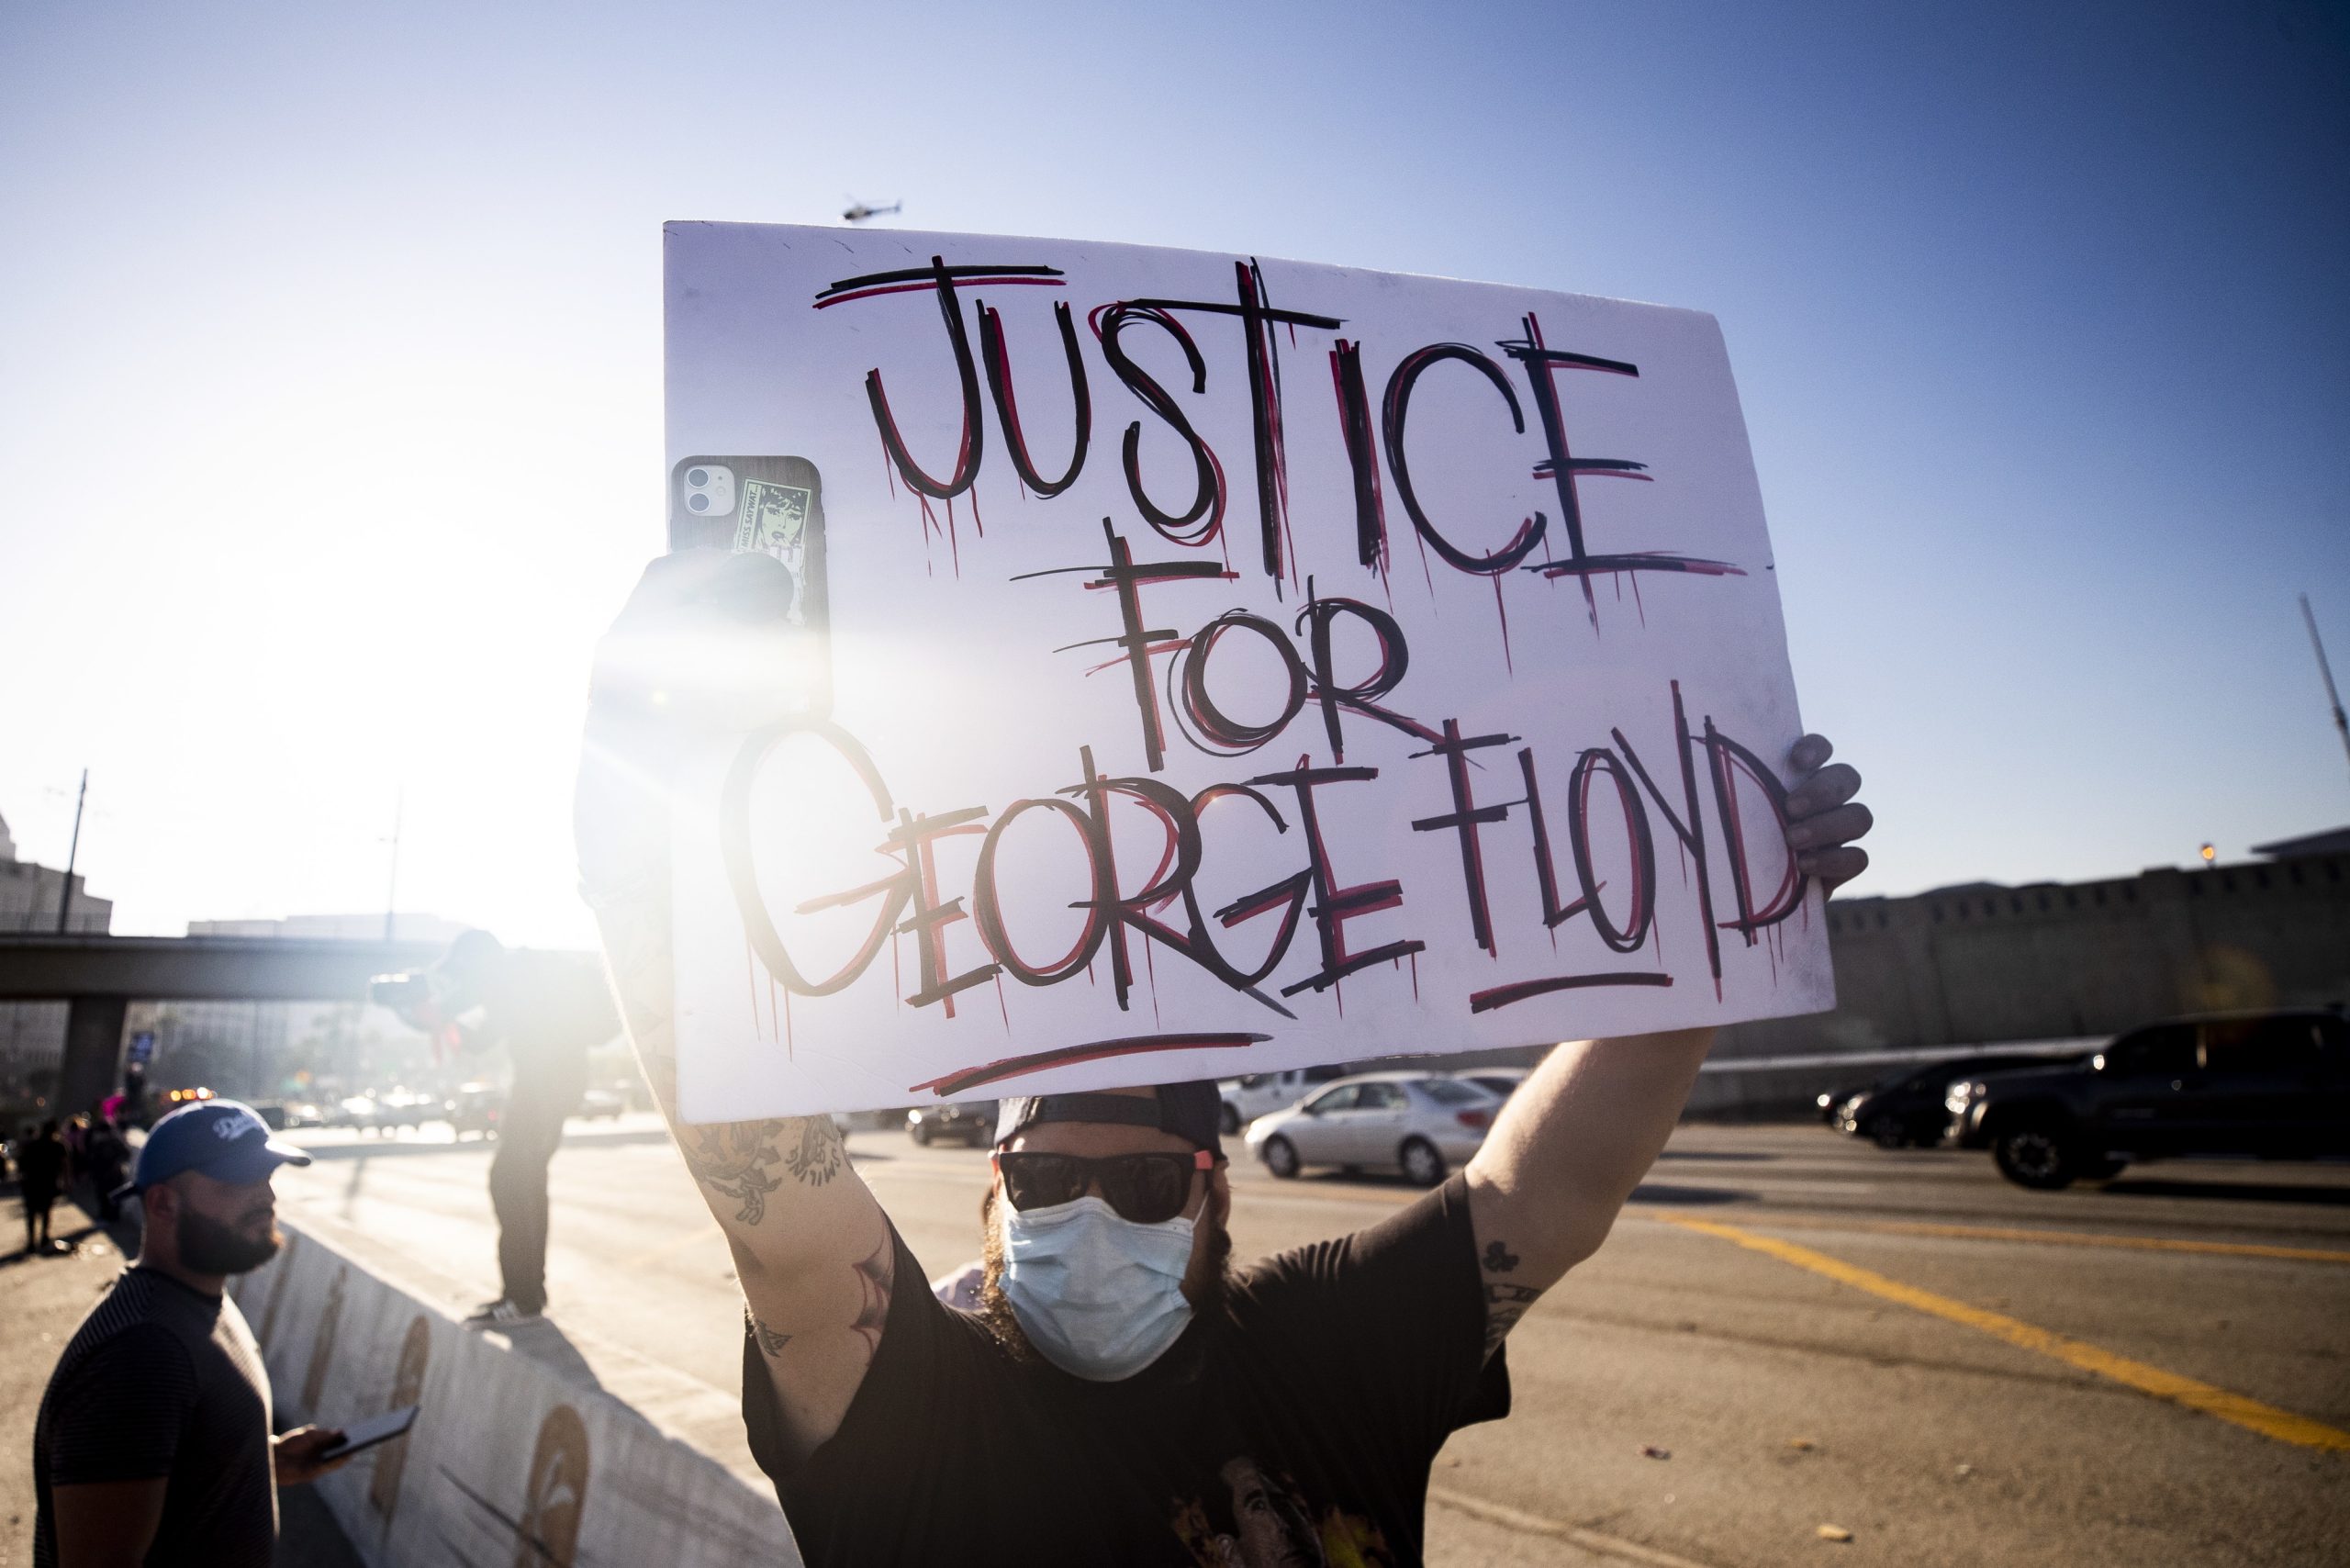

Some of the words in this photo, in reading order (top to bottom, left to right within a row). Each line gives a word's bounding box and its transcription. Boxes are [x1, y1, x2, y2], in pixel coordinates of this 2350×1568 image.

[812, 255, 1747, 606] JUSTICE
[1012, 517, 1445, 773] FOR
[720, 719, 1427, 1019] GEORGE
[1410, 680, 1809, 1002] FLOYD
